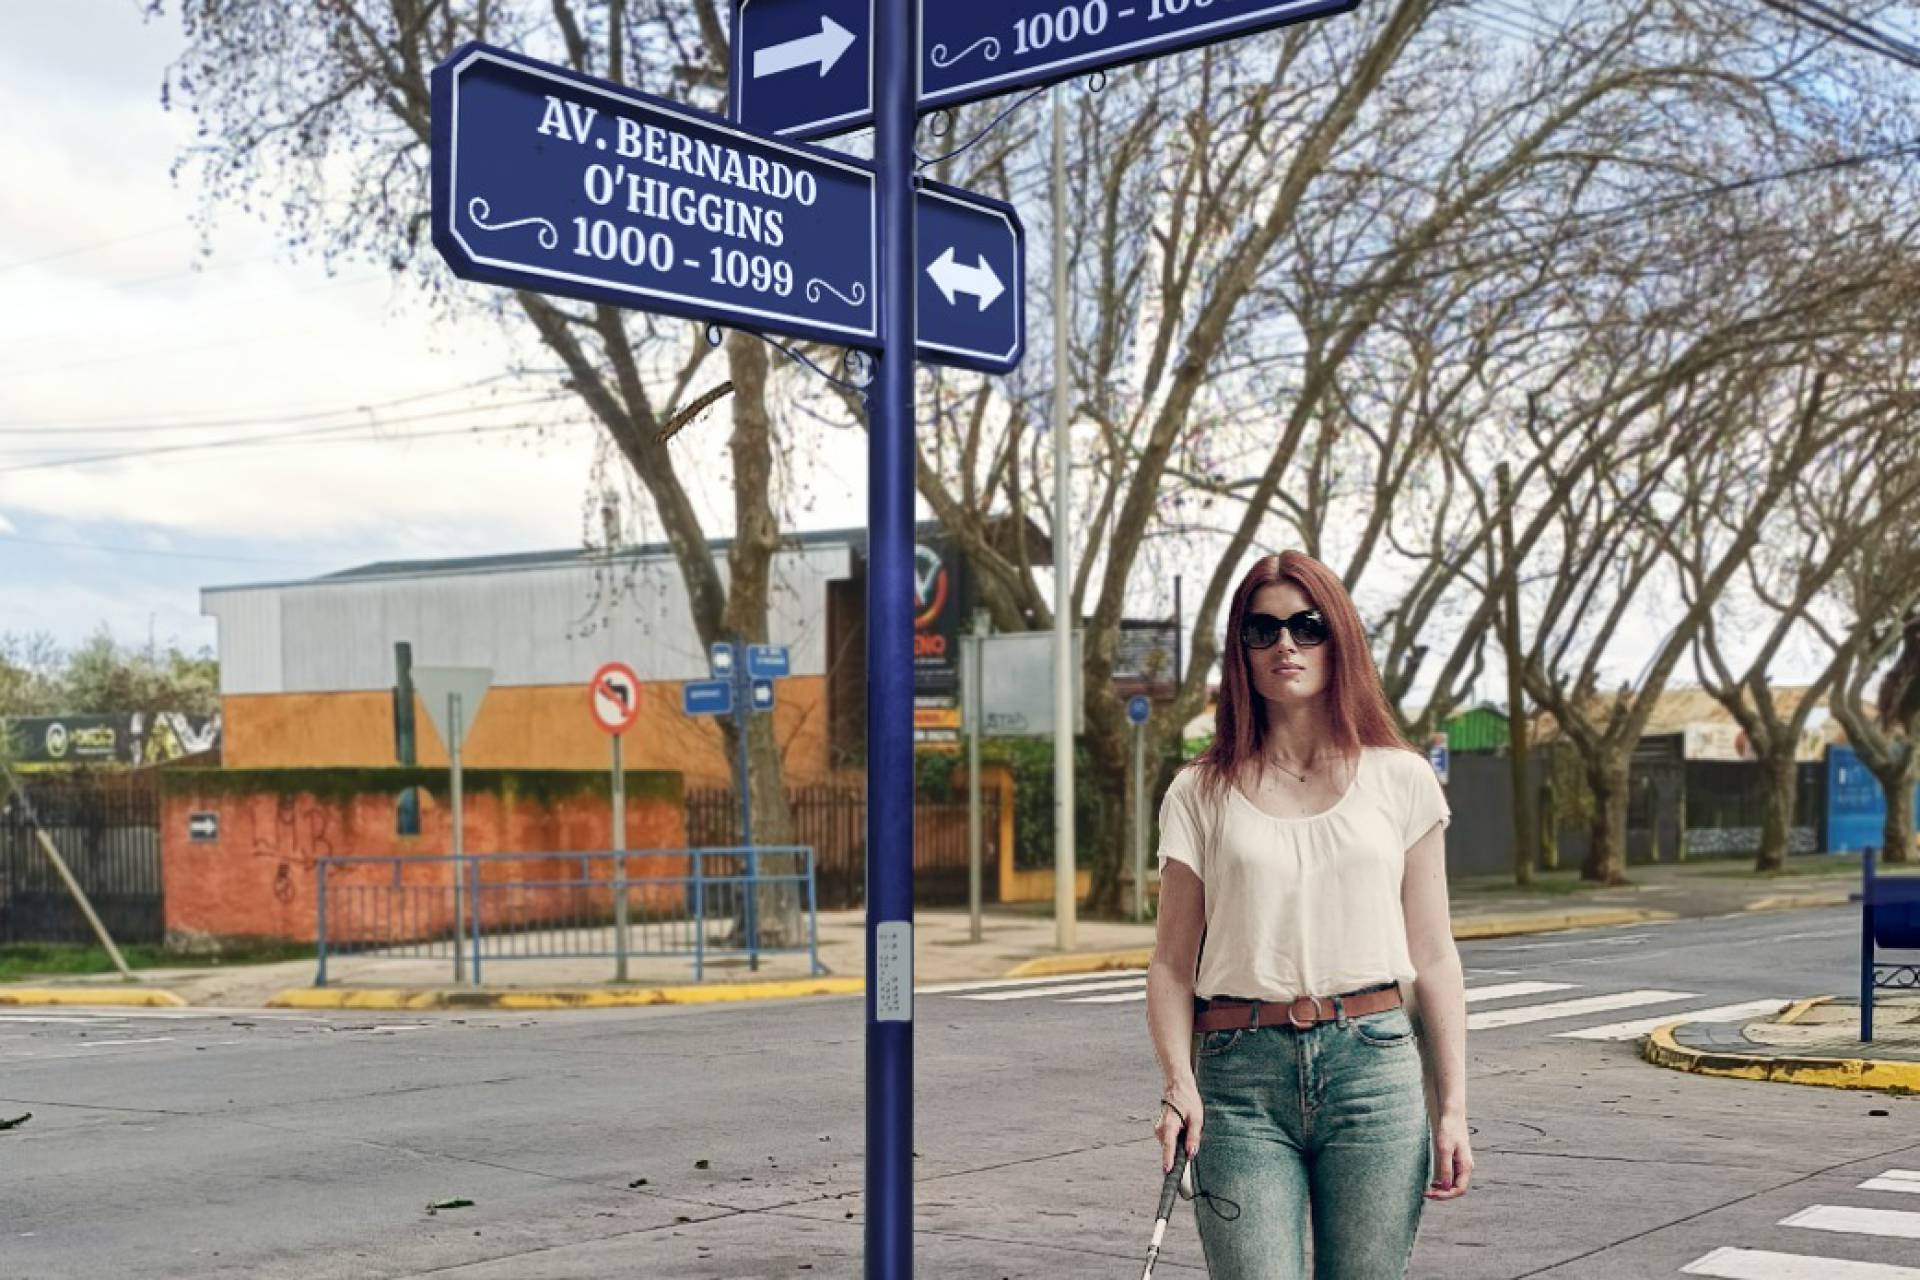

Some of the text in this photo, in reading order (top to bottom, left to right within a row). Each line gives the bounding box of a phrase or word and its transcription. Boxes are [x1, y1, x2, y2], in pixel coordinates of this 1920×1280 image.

[1012, 0, 1109, 54] 1000
[537, 95, 817, 206] AV. BERNARDO
[583, 163, 784, 247] O'HIGGINS
[572, 216, 793, 297] 1000 - 1099
